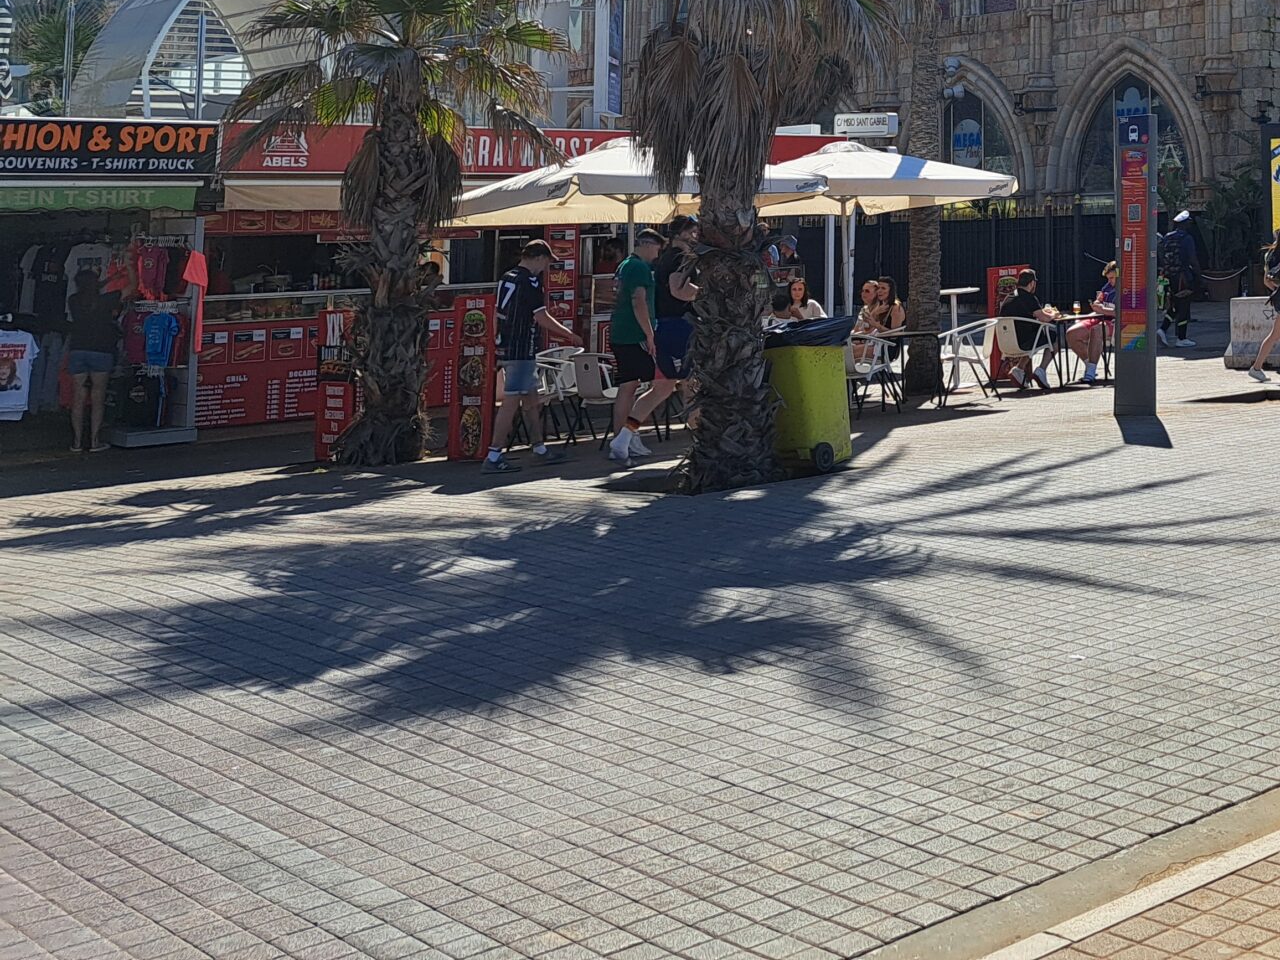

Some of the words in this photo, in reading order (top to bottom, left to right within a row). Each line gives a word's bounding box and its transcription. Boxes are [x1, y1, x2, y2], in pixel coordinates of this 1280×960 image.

[0, 122, 82, 152] HION
[88, 125, 112, 152] &
[118, 125, 215, 153] SPORT
[0, 156, 78, 170] SOUVENIRS
[91, 157, 148, 170] T-SHIRT
[148, 158, 195, 170] DRUCK
[262, 156, 307, 167] ABEL'S
